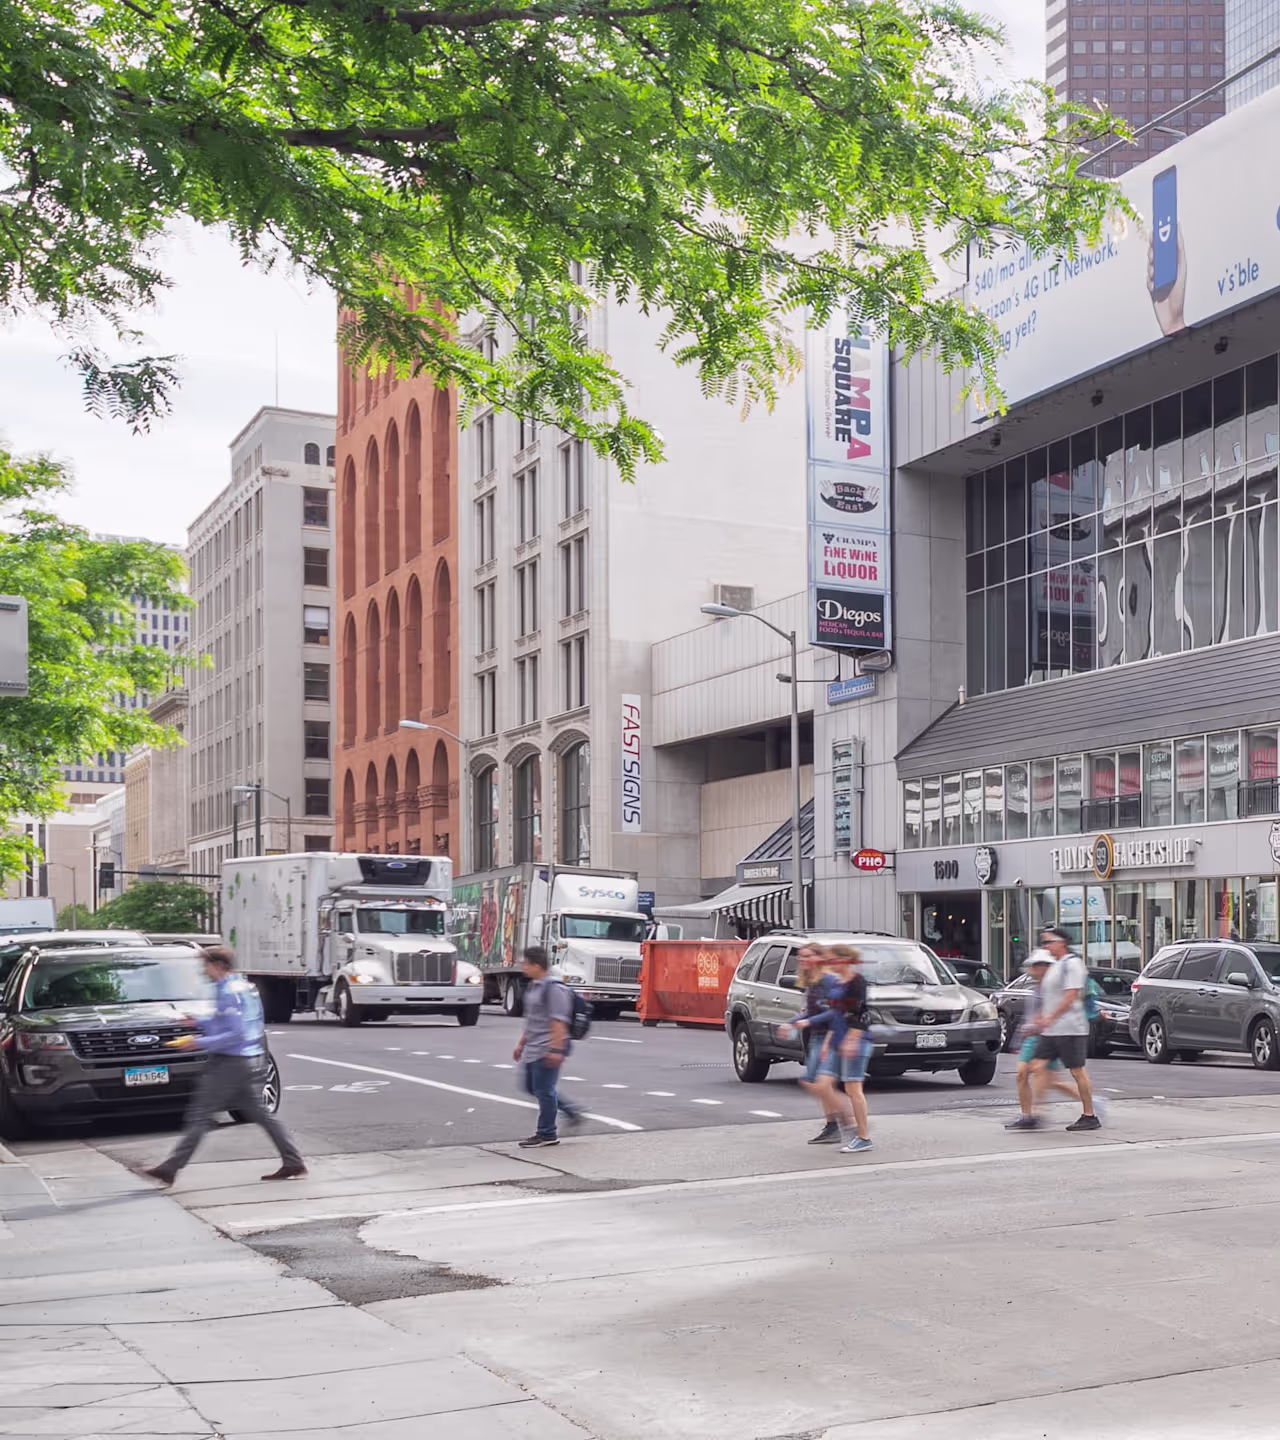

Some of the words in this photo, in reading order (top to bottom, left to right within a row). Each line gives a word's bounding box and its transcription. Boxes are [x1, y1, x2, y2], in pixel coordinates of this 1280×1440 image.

[975, 261, 1015, 296] $40/mo
[1023, 275, 1039, 302] 4G
[1064, 233, 1118, 280] Network.
[1015, 310, 1037, 347] yet?
[833, 337, 852, 443] SQUARE
[817, 599, 881, 627] Diegos
[858, 856, 883, 866] PHO
[1112, 837, 1193, 866] BARBERSHOP
[933, 860, 959, 879] 1600
[578, 886, 625, 900] Sysco
